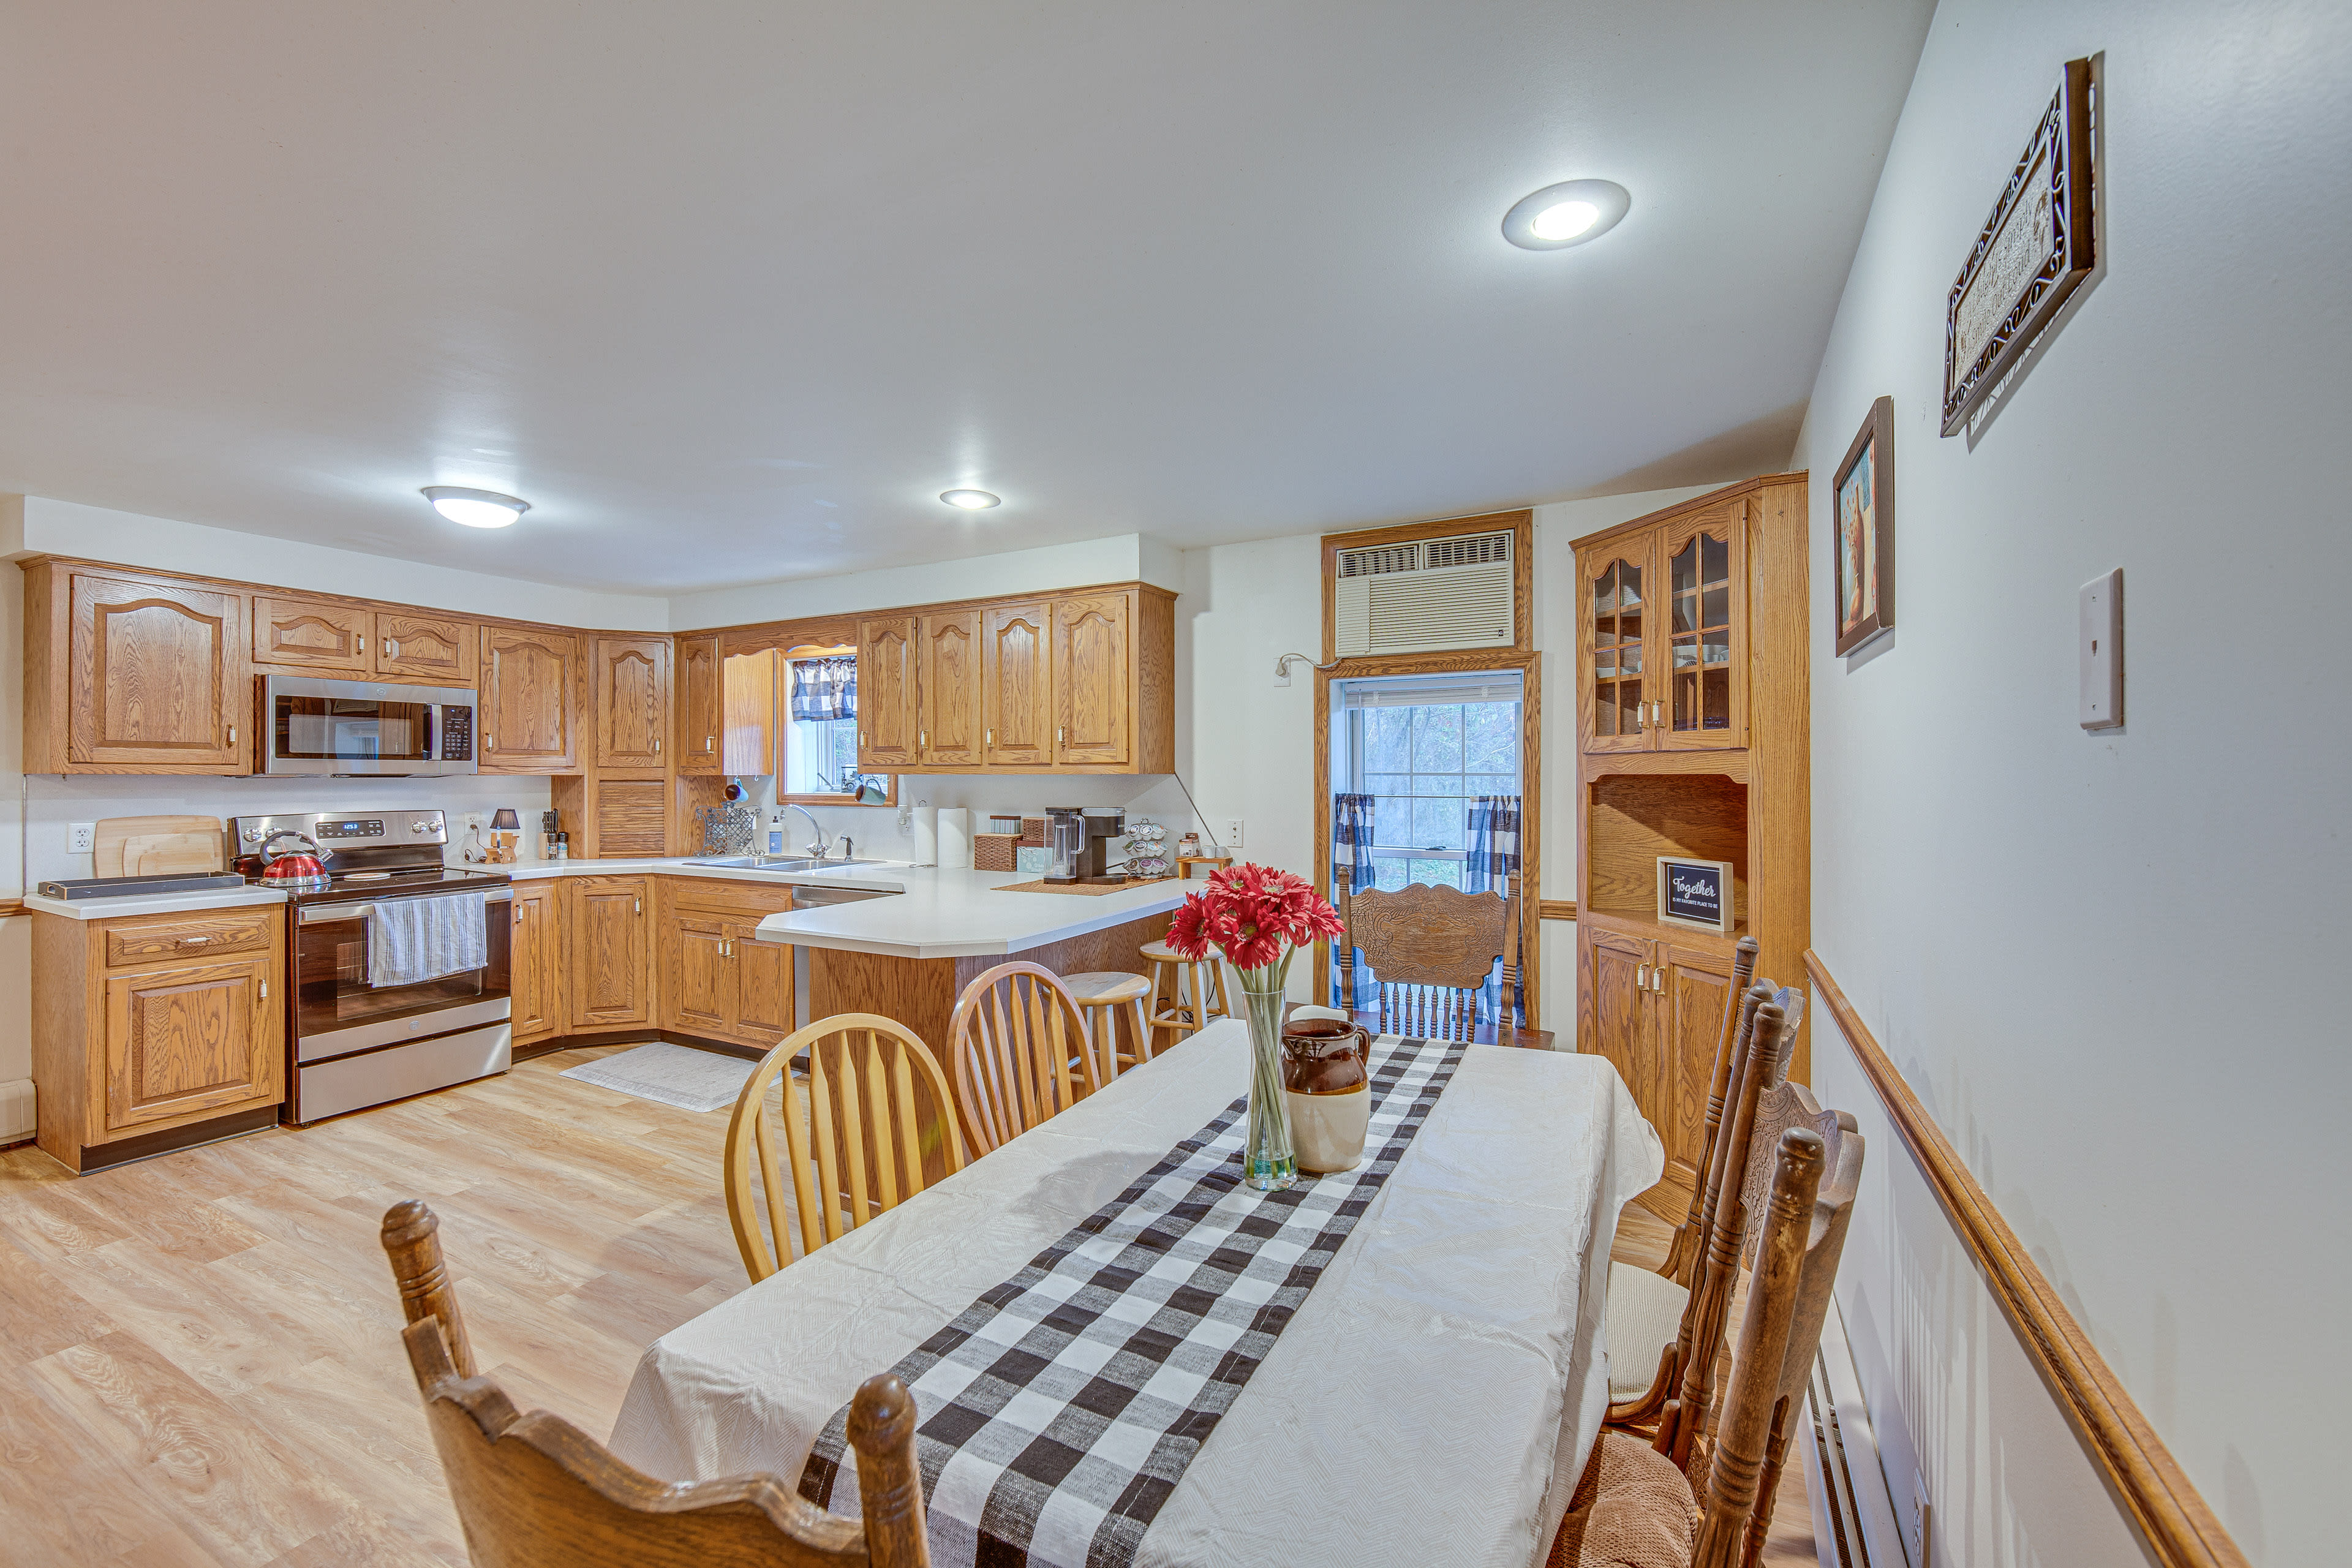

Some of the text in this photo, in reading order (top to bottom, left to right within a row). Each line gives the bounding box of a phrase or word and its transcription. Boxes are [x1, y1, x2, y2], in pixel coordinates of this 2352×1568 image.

[1972, 307, 1991, 352] Smile
[1992, 279, 2007, 317] Out
[2008, 238, 2030, 294] Loud
[1673, 876, 1716, 899] Together
